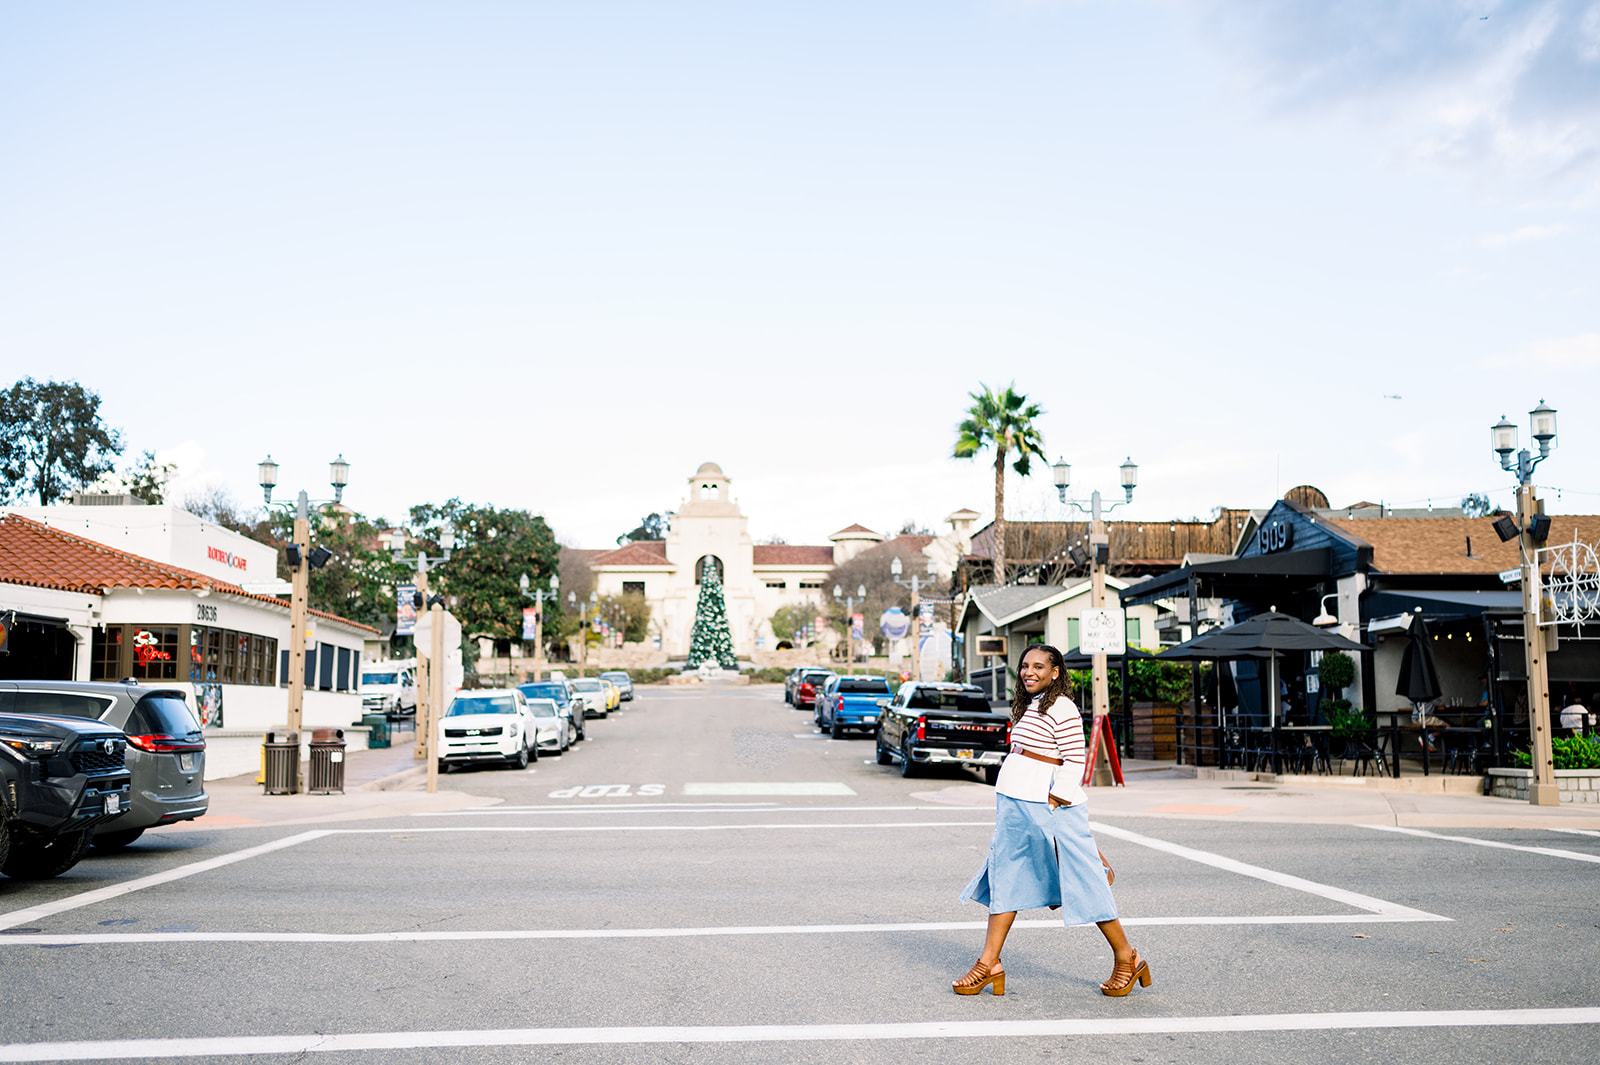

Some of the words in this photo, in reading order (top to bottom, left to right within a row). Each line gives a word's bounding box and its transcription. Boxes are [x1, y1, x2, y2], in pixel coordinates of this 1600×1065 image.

[1257, 521, 1286, 554] 1909
[197, 604, 217, 621] 28636
[144, 645, 171, 661] Open
[931, 723, 1002, 732] CHEVROLET
[548, 784, 666, 799] STOP
